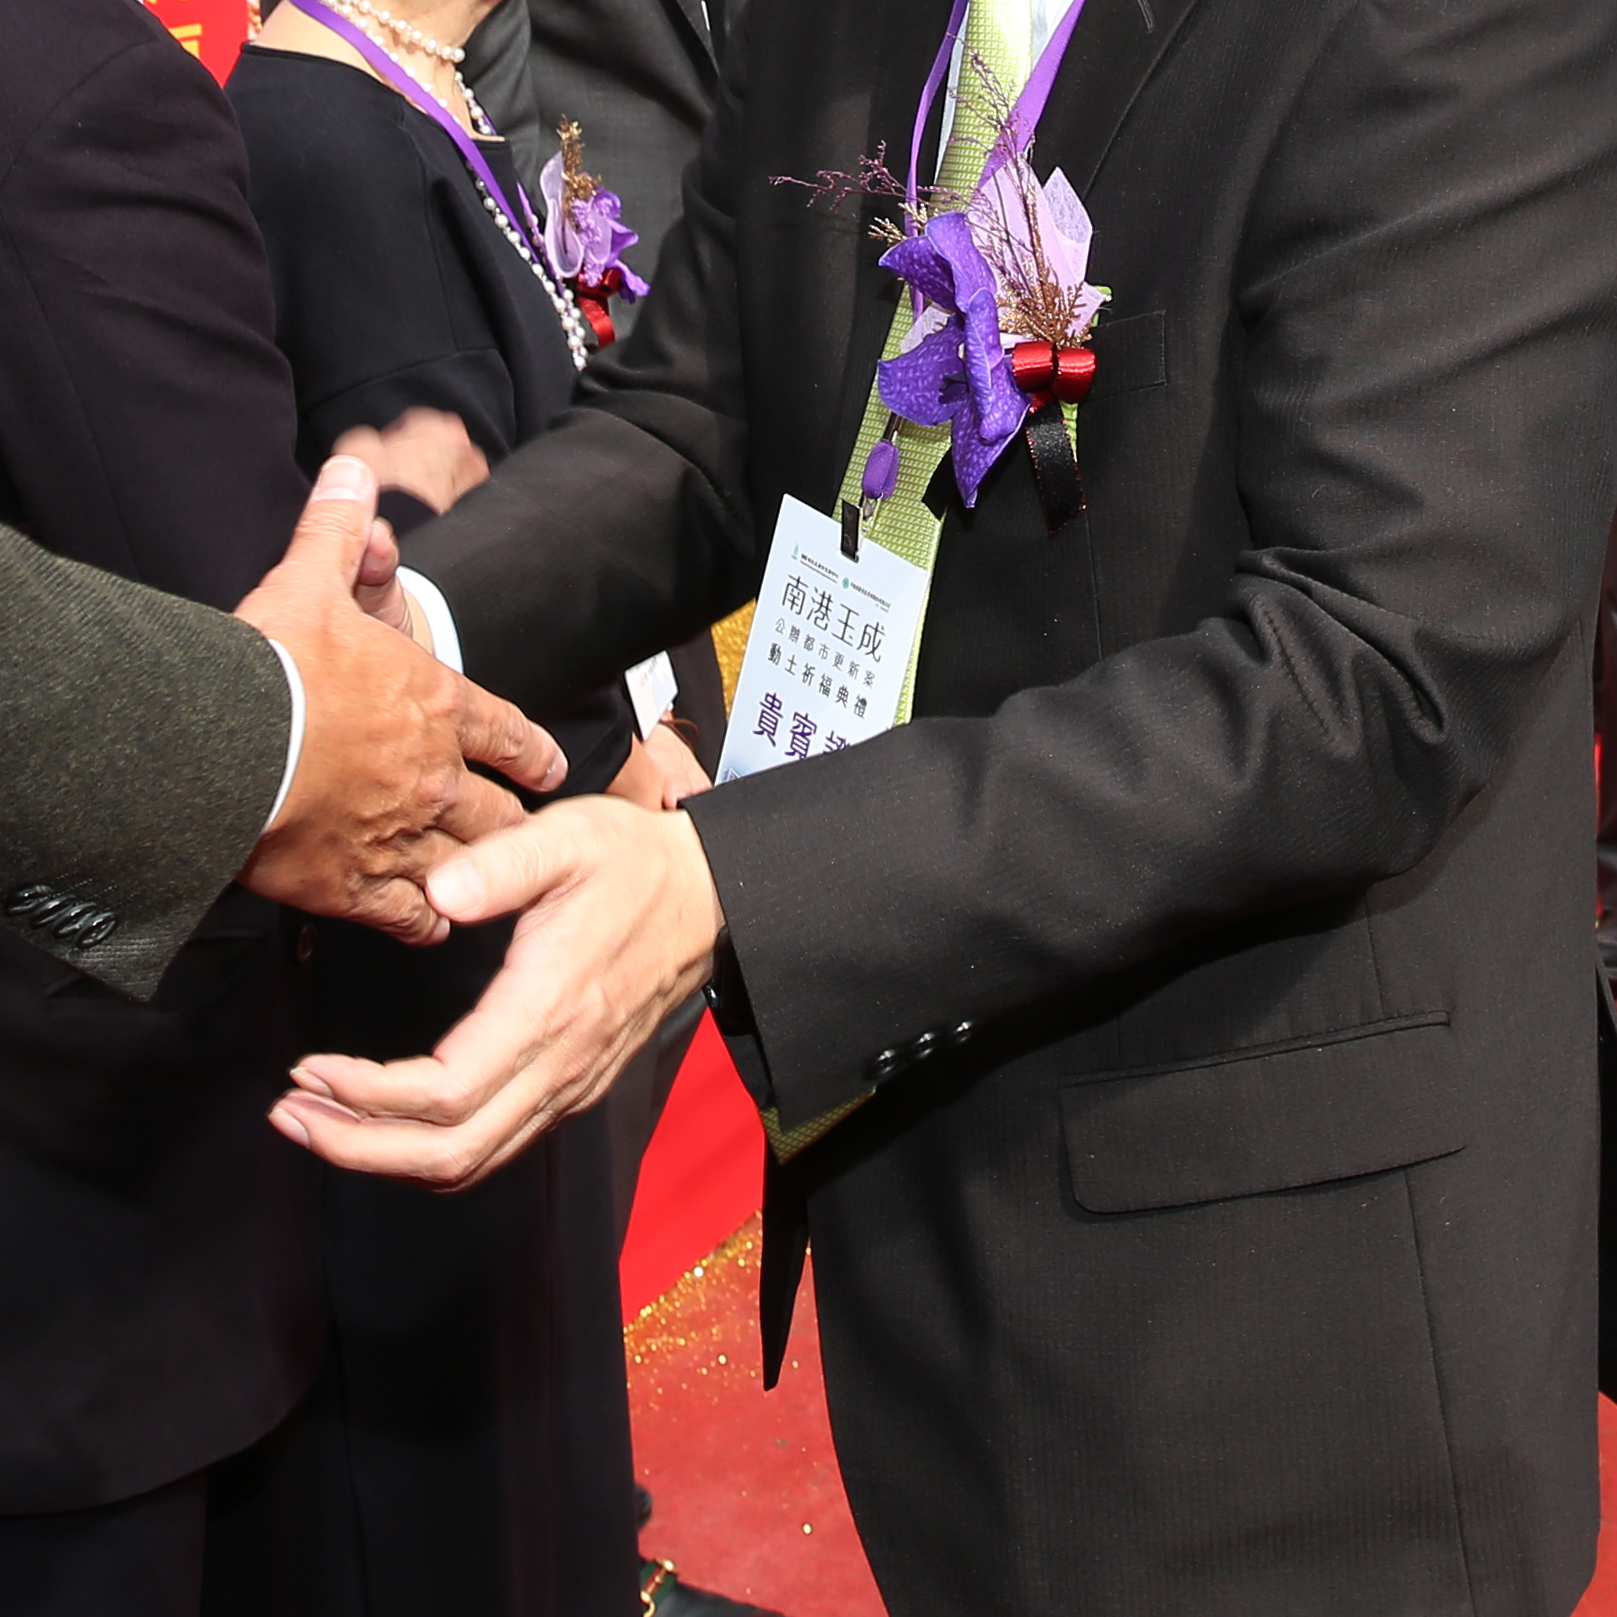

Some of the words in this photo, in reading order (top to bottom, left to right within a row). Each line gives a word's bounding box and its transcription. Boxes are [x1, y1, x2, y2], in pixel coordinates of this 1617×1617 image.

[775, 616, 876, 689] 公辦都市更新案
[781, 573, 886, 663] 南港玉成
[767, 642, 869, 720] 動土祈福典禮
